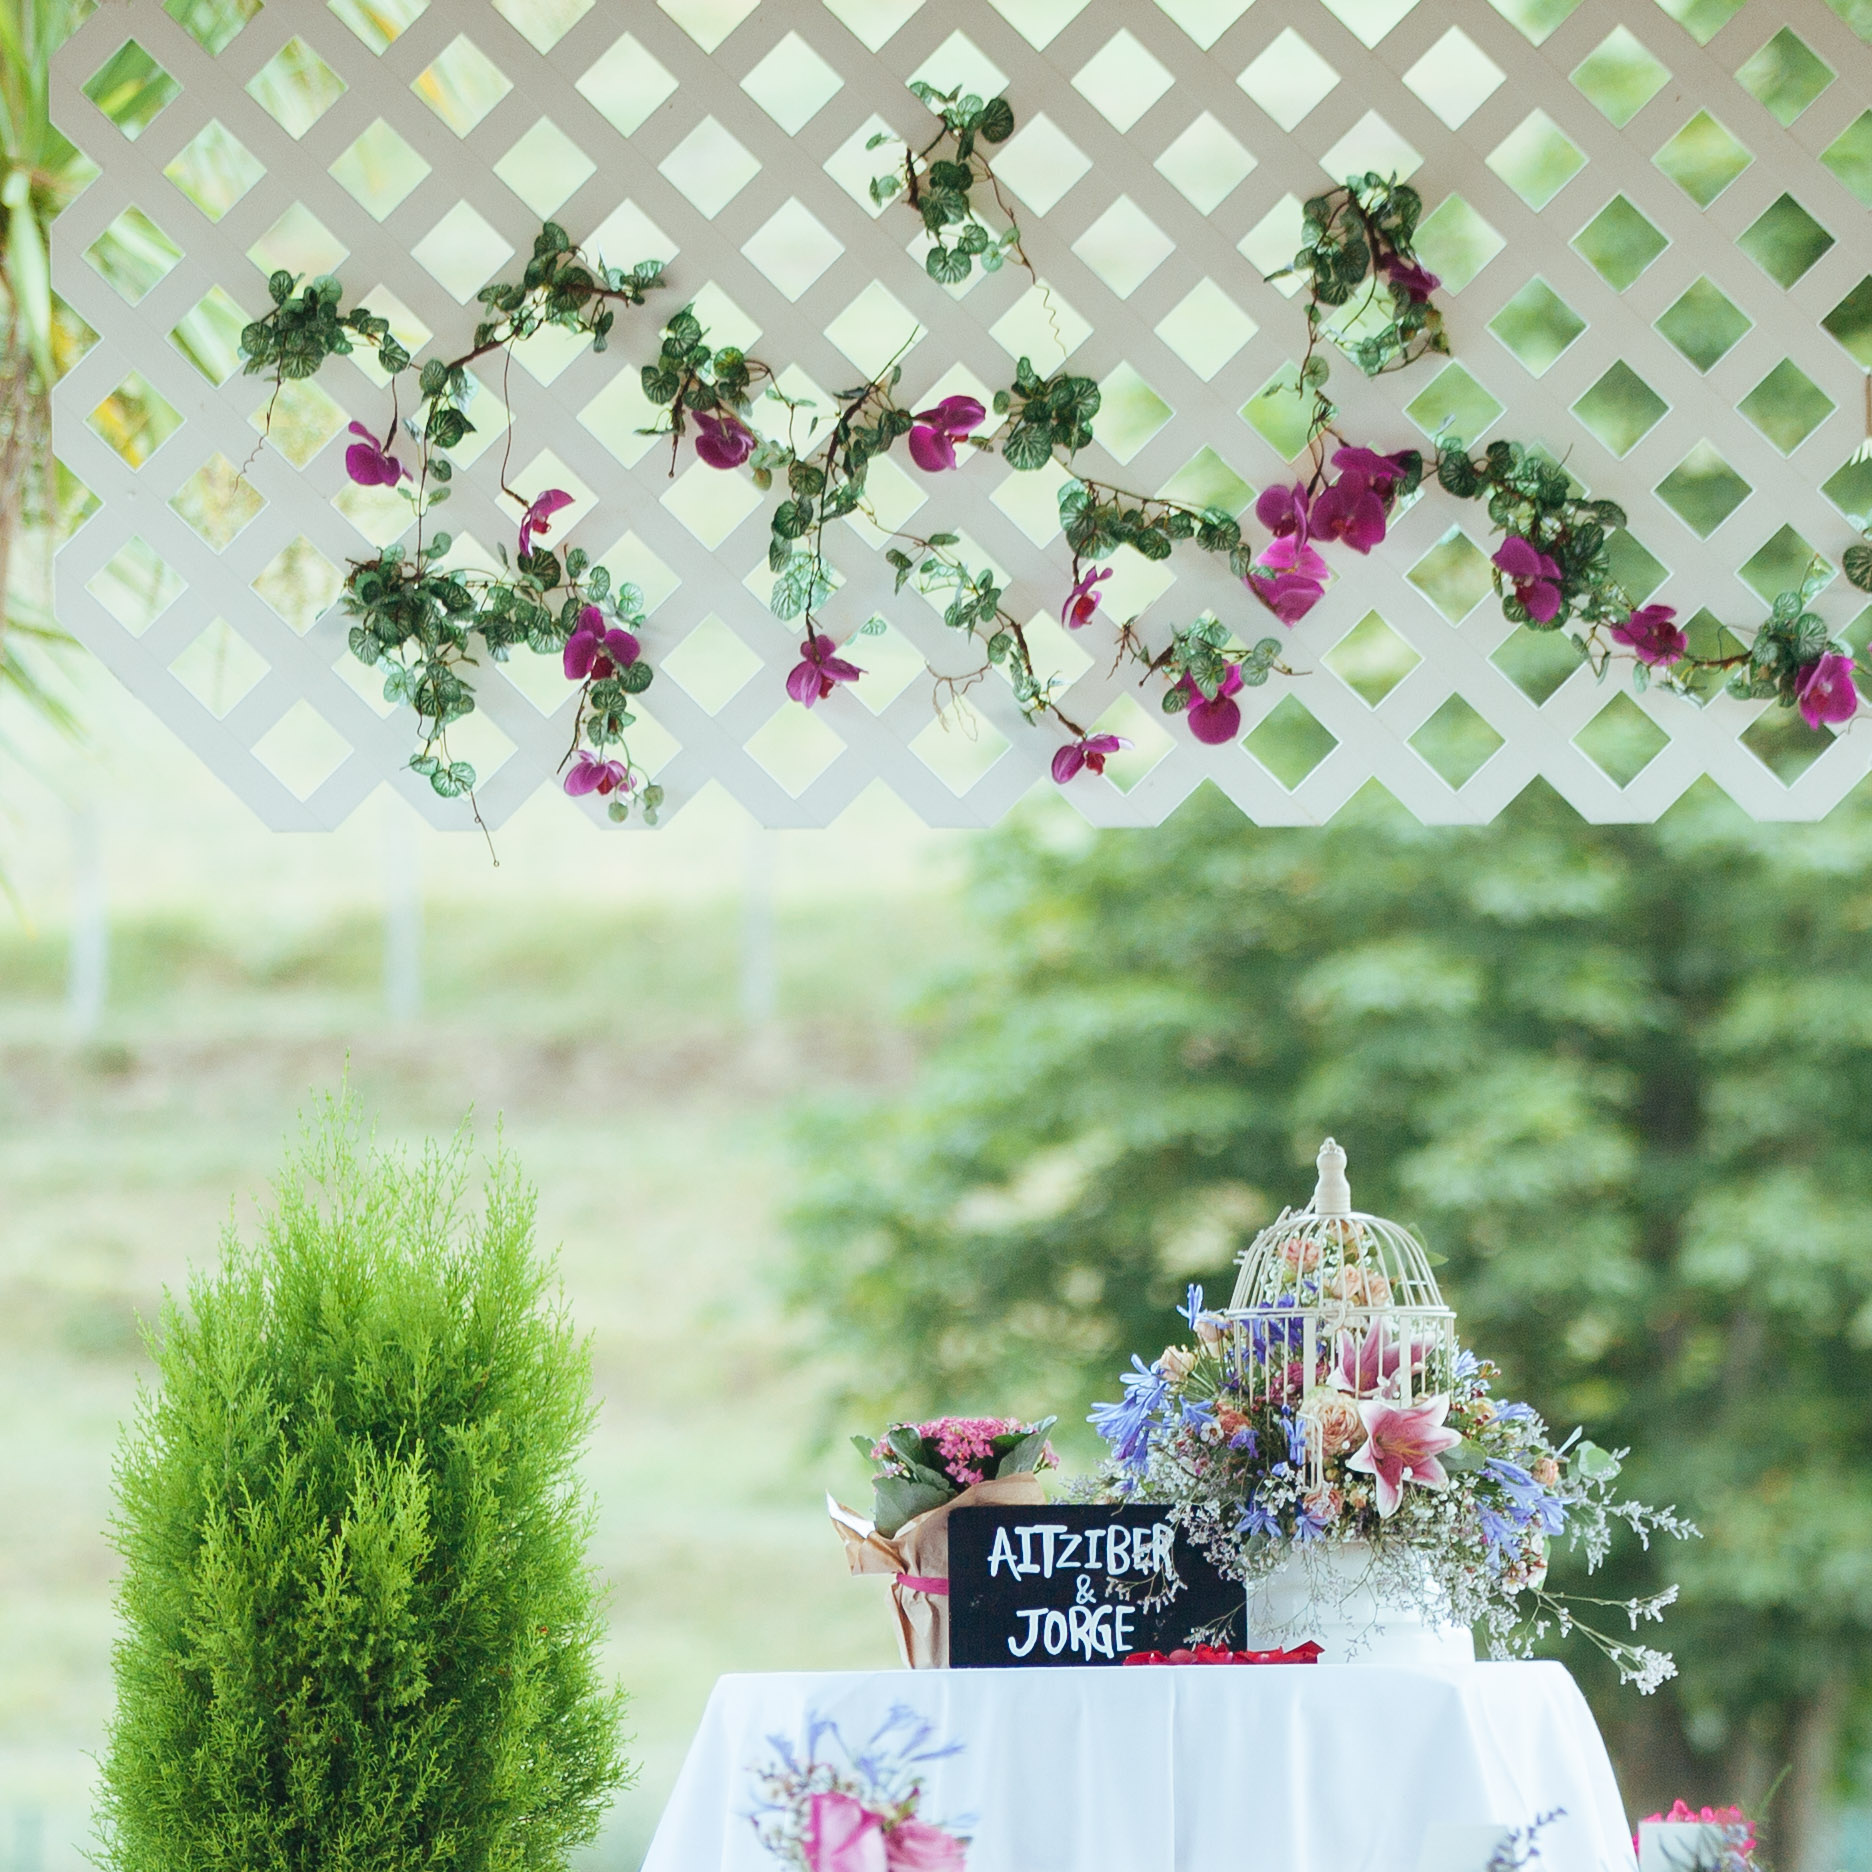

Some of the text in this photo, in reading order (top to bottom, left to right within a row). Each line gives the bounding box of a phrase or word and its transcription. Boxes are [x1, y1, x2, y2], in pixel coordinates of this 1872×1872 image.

[987, 1523, 1175, 1581] AITZIBER
[1076, 1573, 1096, 1604] &
[1007, 1604, 1136, 1661] JORGE
